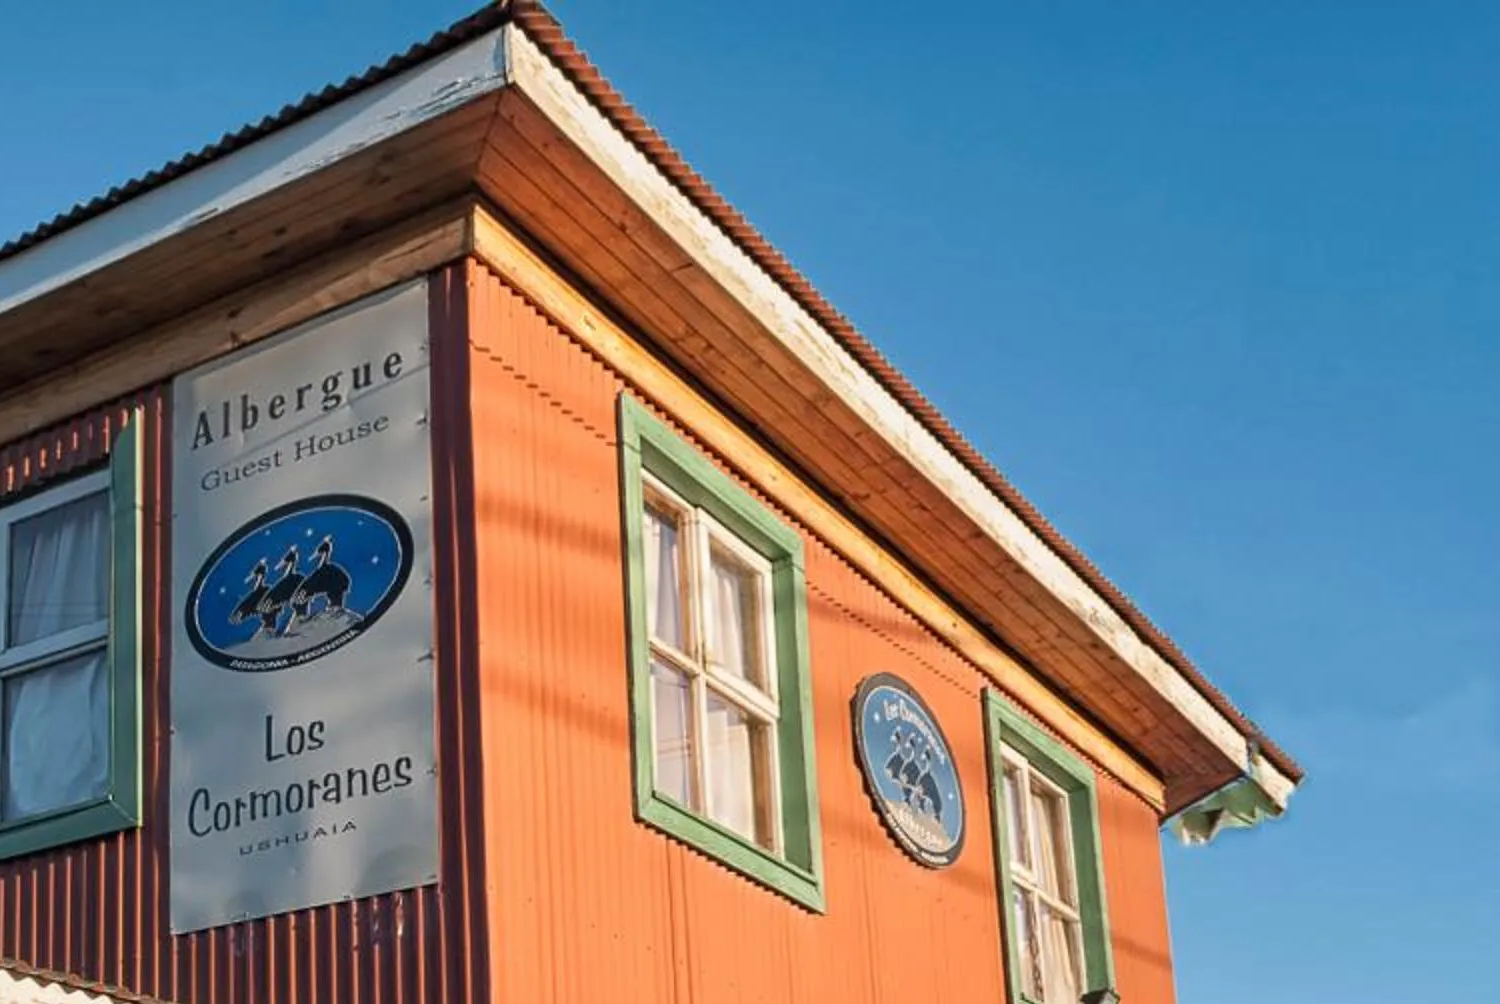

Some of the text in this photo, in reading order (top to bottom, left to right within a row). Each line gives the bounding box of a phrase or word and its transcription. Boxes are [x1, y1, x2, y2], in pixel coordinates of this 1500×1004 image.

[190, 351, 403, 450] Albergue
[200, 414, 390, 491] Guest House
[264, 714, 325, 762] Los
[187, 756, 413, 837] Cormoranes
[239, 820, 357, 856] USHUAIA
